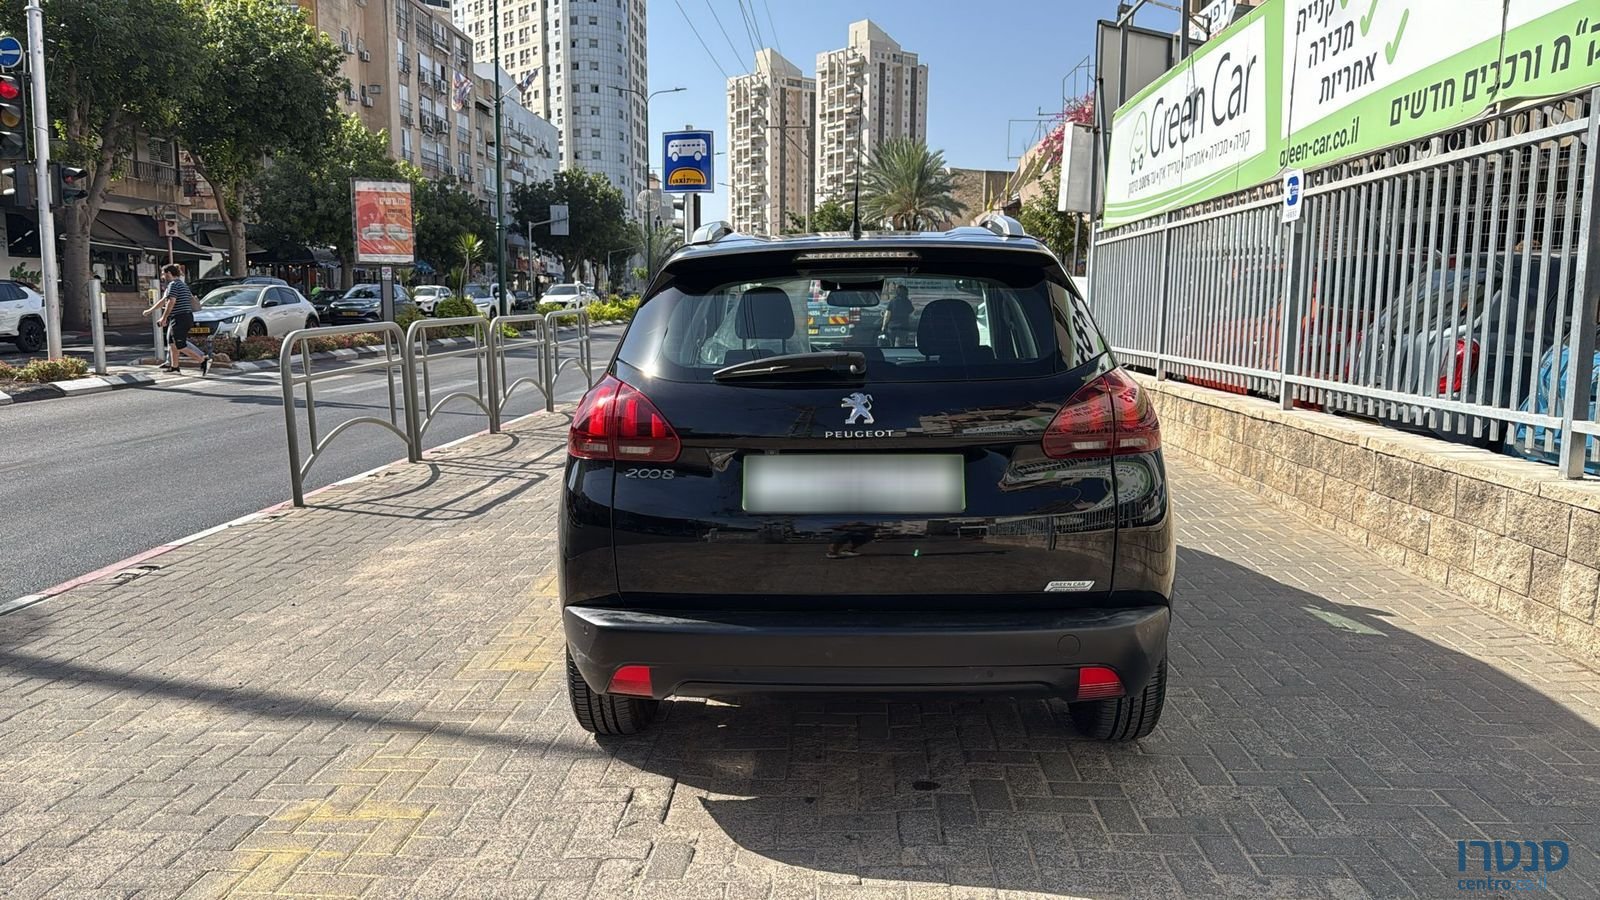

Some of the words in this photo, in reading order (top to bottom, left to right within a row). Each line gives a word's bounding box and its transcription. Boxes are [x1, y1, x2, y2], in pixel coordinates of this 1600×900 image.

[1296, 0, 1335, 35] קנייה
[1308, 20, 1354, 69] מכירה
[1319, 51, 1378, 105] אחריות
[1463, 44, 1543, 103] ורכבים
[1150, 87, 1205, 158] Green
[1212, 52, 1257, 127] Car
[1390, 78, 1456, 126] חדשים
[1209, 138, 1228, 161] מכירה
[1233, 129, 1250, 152] קניה
[825, 429, 894, 438] PEUGEOT
[625, 468, 675, 480] 2008
